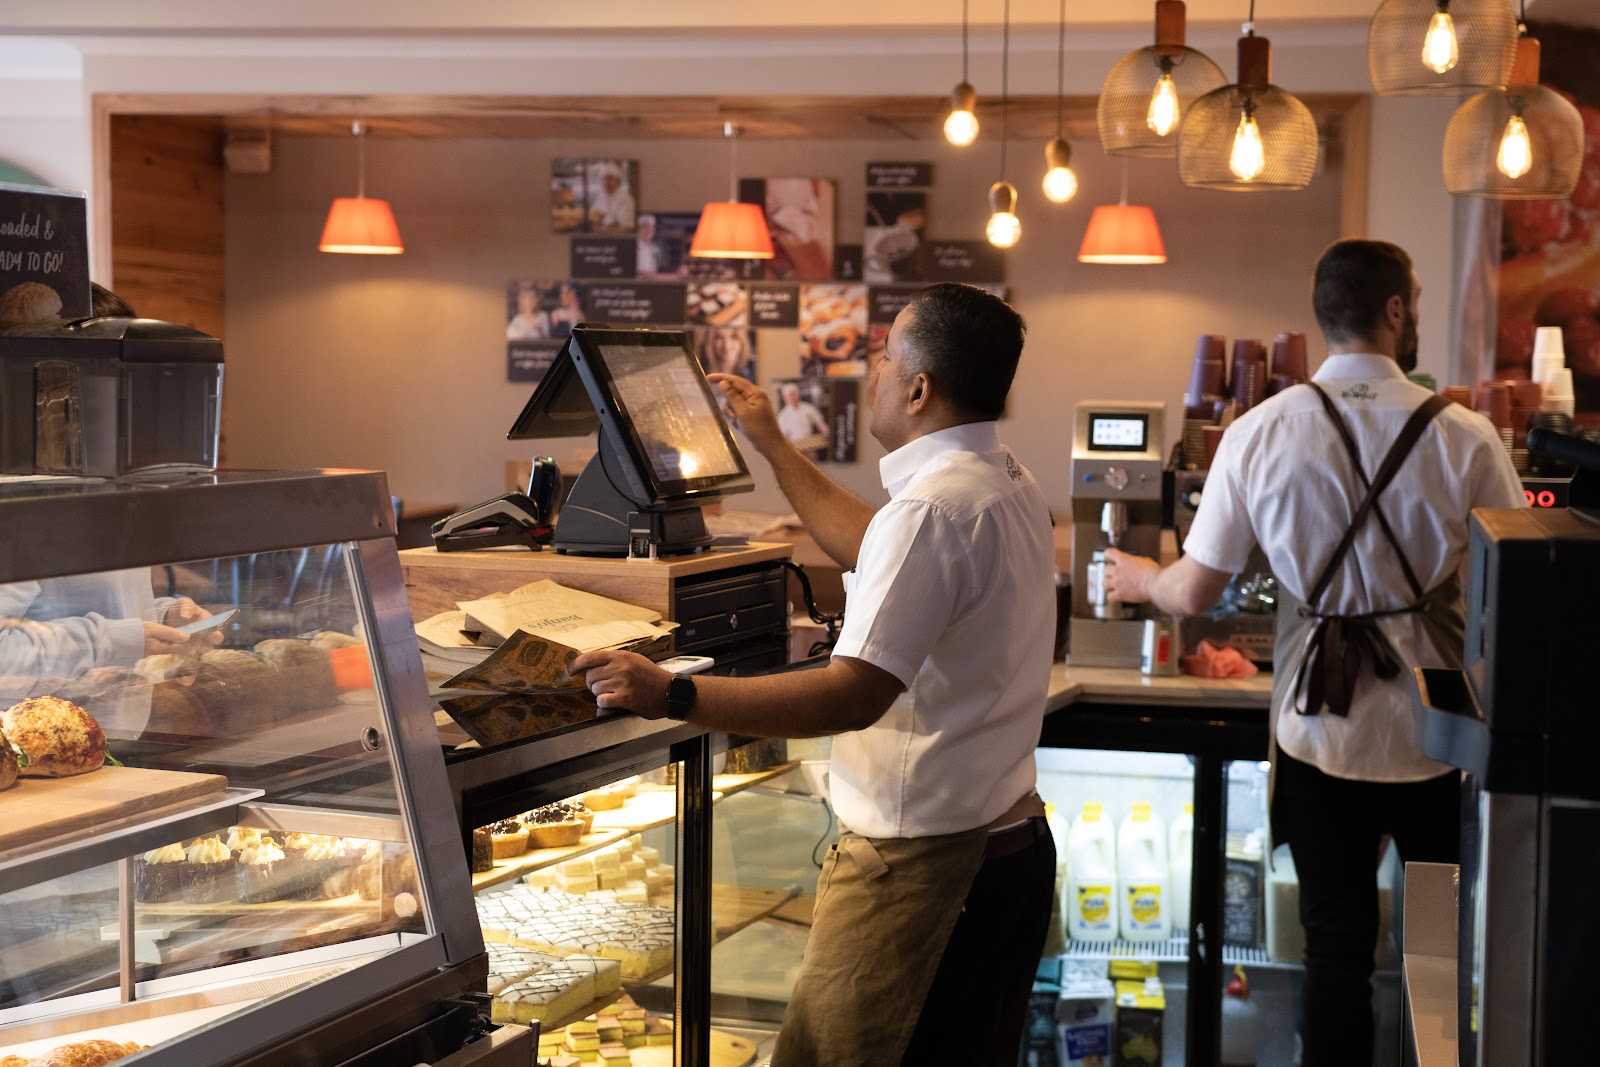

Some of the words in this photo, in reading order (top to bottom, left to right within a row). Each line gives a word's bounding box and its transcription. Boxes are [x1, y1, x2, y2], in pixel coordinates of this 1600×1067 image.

[0, 212, 41, 239] oaded
[44, 220, 54, 240] &
[0, 250, 22, 271] ADY
[27, 251, 41, 271] TO
[43, 251, 63, 274] GO!
